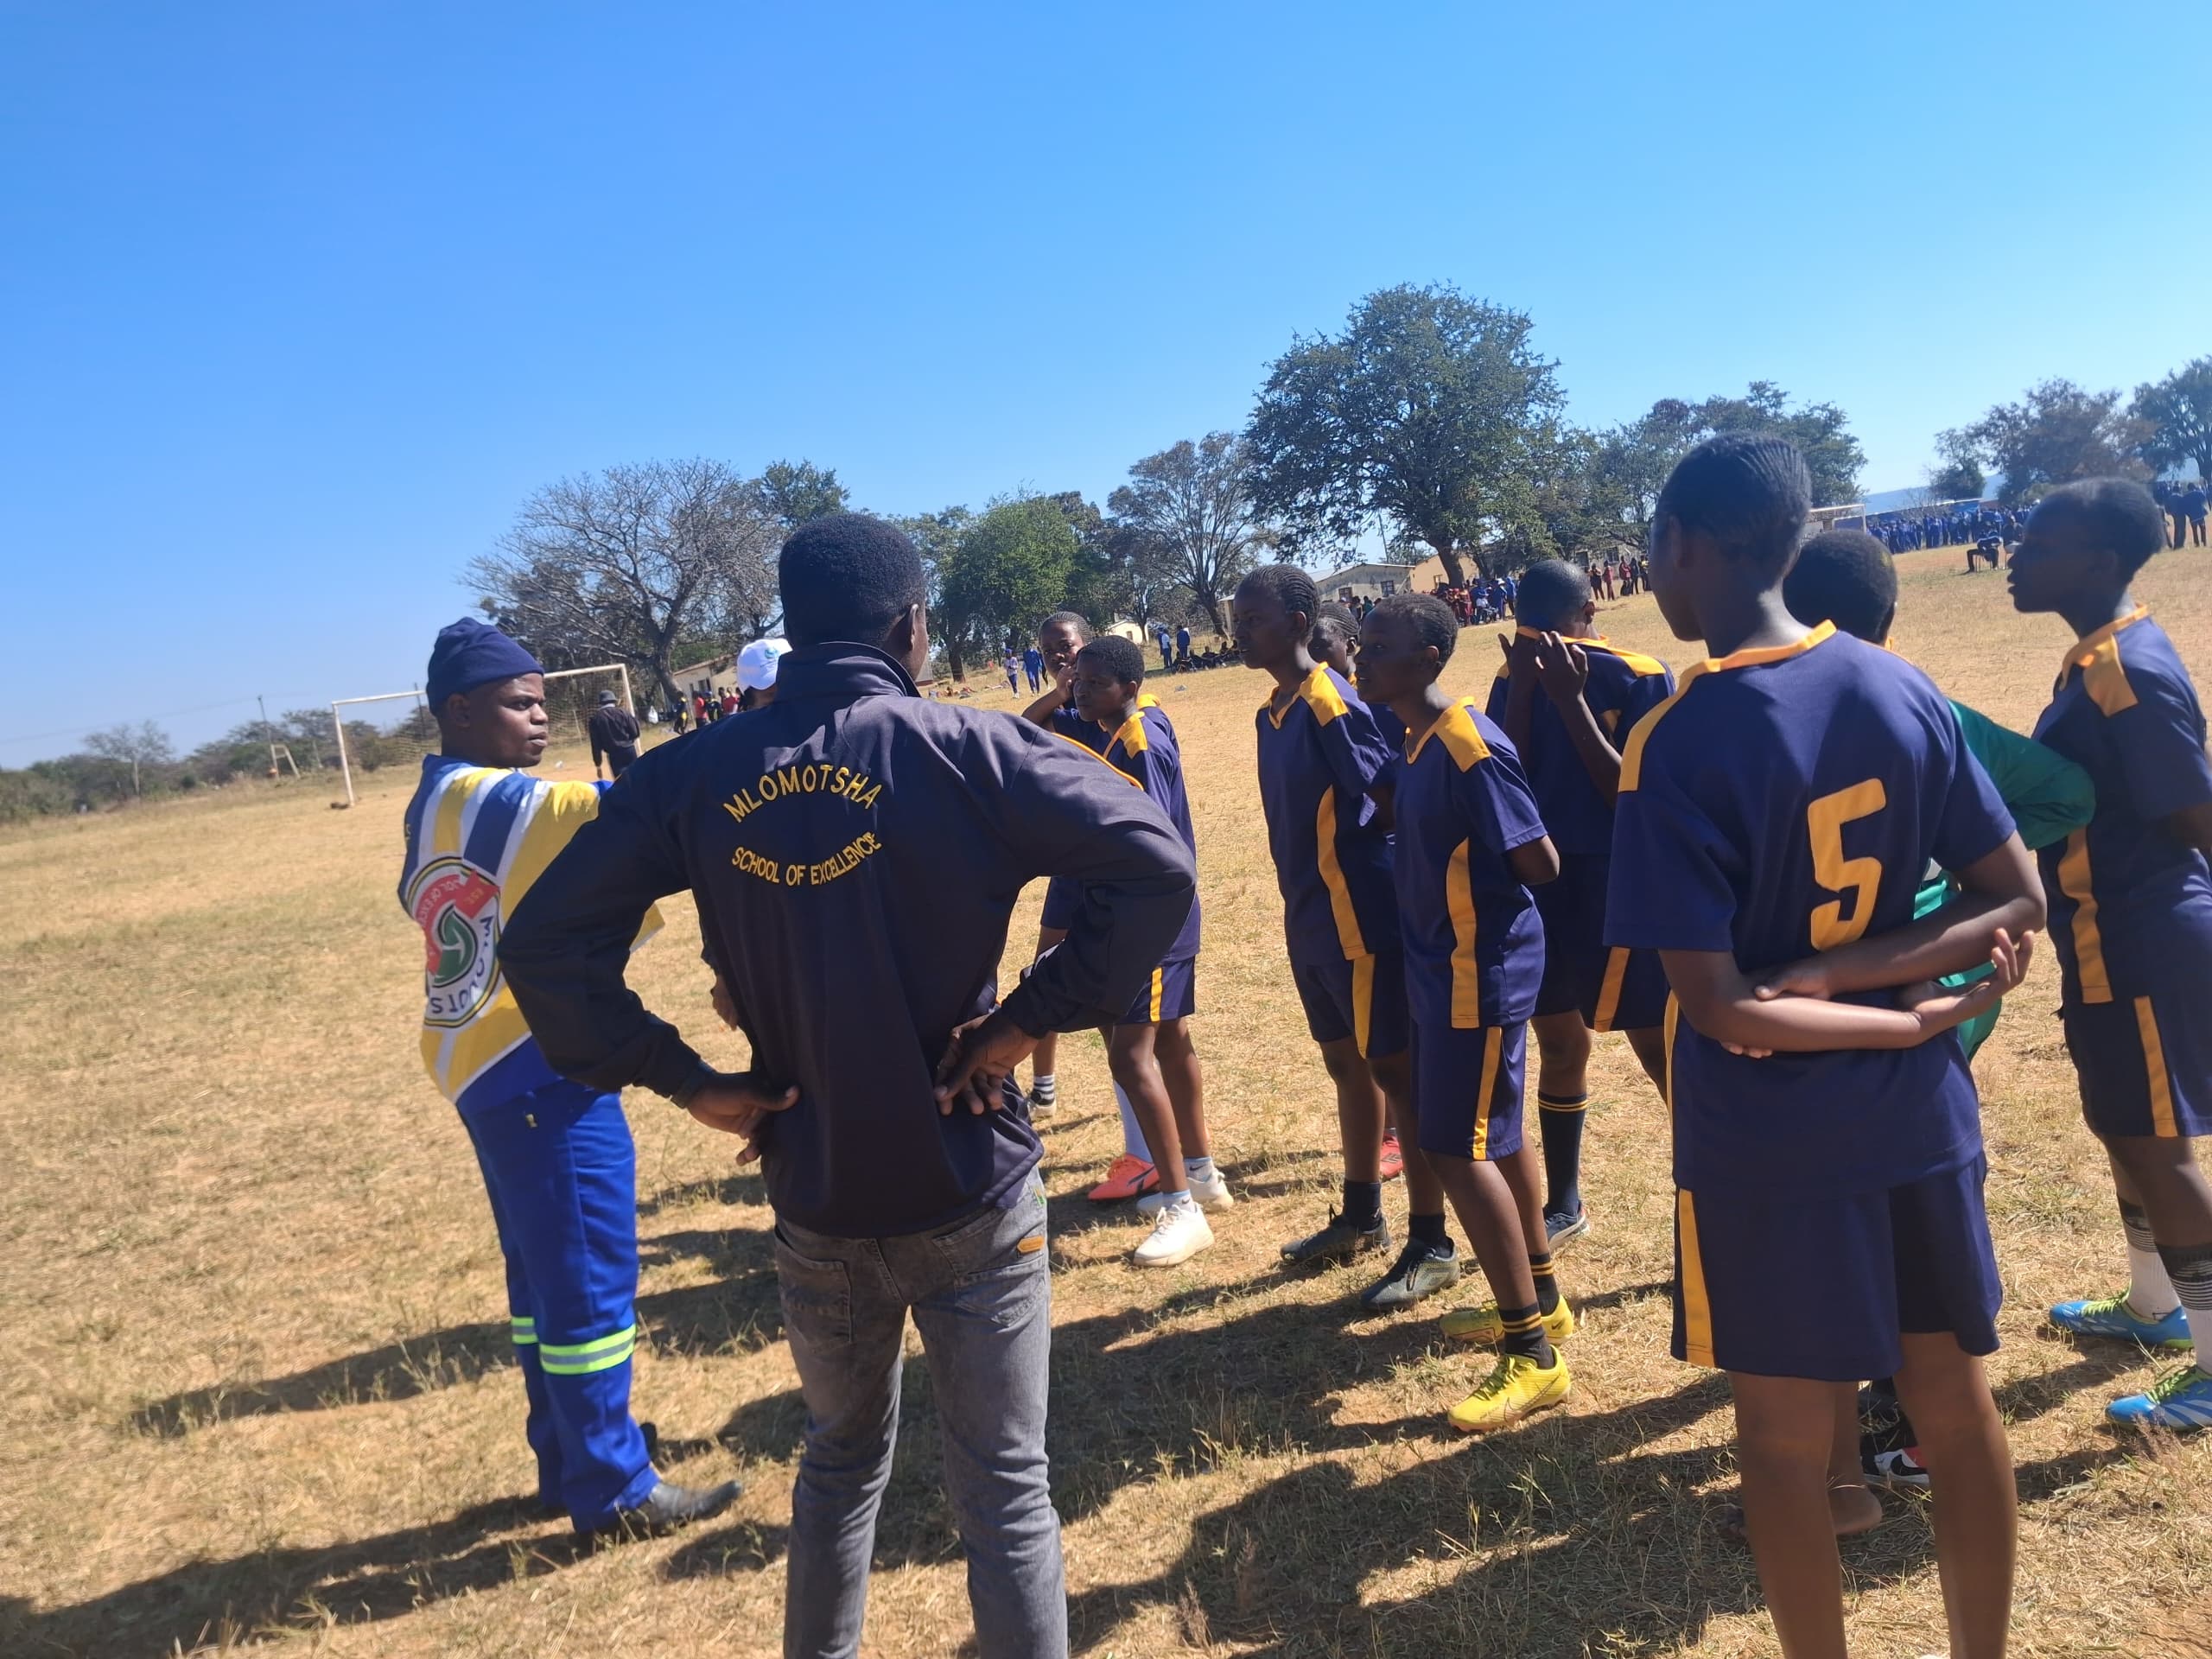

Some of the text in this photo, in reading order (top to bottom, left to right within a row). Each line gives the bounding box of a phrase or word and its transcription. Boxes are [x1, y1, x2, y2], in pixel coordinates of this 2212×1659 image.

[723, 764, 882, 823] MLOMOTSHA
[732, 831, 882, 886] SCHOOL OF EXCELLENCE
[1808, 778, 1886, 951] 5
